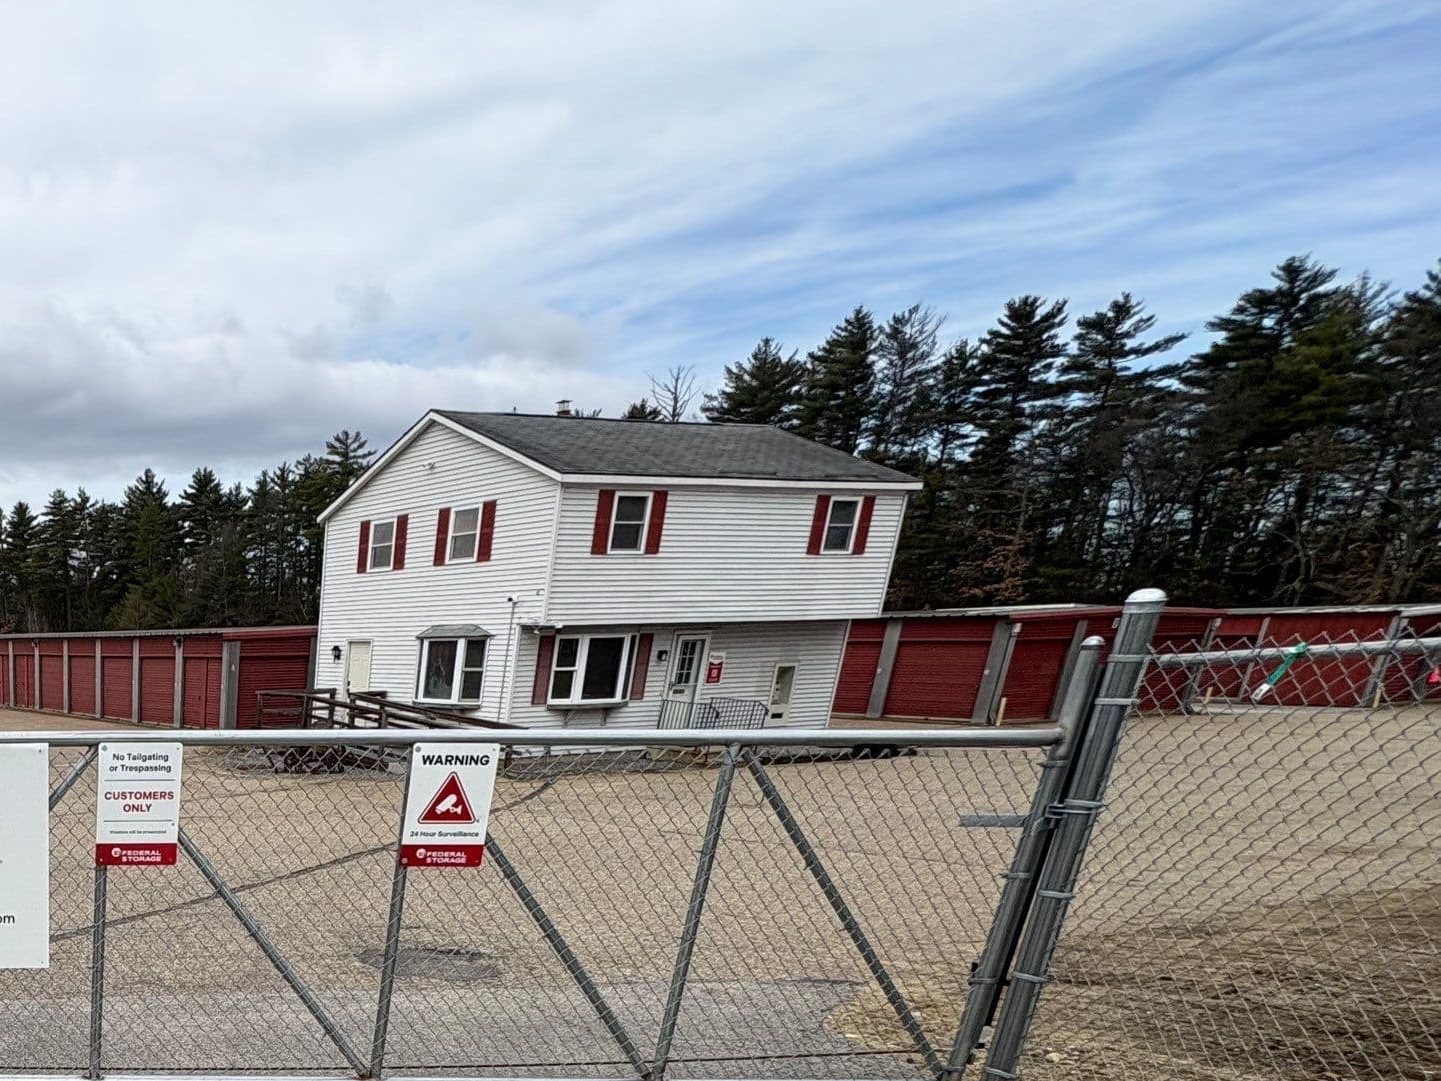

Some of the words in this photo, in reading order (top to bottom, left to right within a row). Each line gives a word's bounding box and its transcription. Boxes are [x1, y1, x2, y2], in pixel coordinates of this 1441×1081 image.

[112, 753, 125, 761] No
[127, 753, 169, 762] Tailgating
[421, 754, 490, 766] WARNING
[120, 764, 172, 773] Trespassing
[104, 791, 174, 801] CUSTOMERS
[123, 803, 152, 813] ONLY
